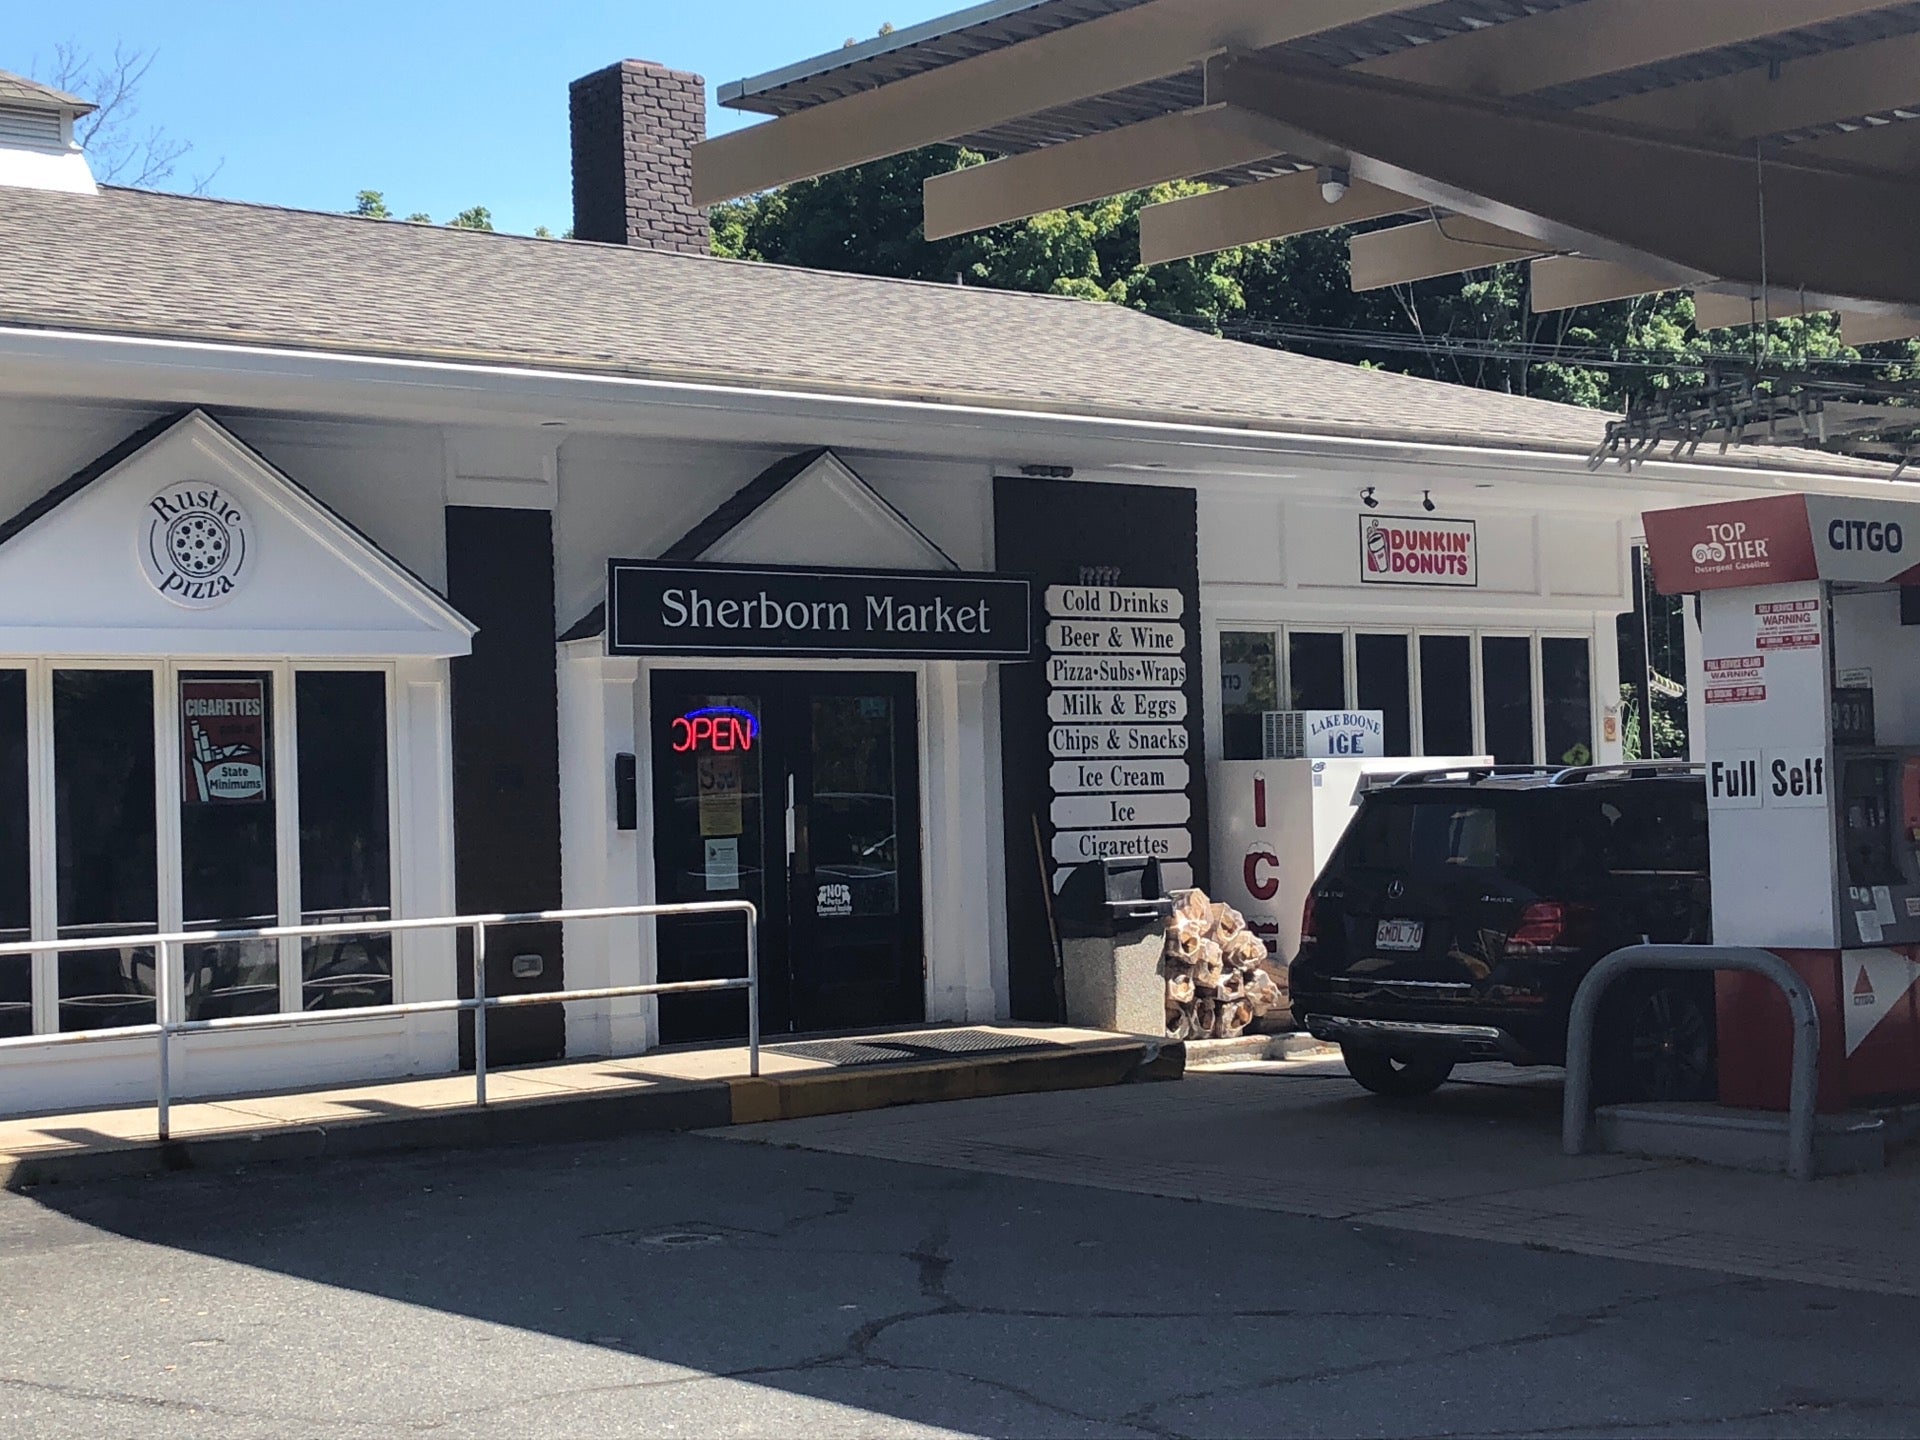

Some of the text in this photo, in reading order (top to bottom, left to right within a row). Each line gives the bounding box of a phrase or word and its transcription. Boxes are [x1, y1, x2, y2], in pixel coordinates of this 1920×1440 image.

[149, 489, 241, 525] Rustic
[1391, 529, 1471, 553] DUNKIN'
[1707, 522, 1746, 543] TOP
[1828, 519, 1903, 553] CITGO
[1725, 540, 1768, 560] TIER
[1391, 552, 1468, 576] DONUTS
[1694, 561, 1770, 574] Detergent Gasoline
[661, 588, 992, 634] Sherborn Market
[1062, 589, 1169, 613] Cold Drinks
[1762, 613, 1811, 625] WARNING
[1060, 625, 1174, 648] Beer & Wine
[1710, 670, 1759, 680] WARNING
[185, 698, 261, 717] CIGARETTES
[1062, 694, 1177, 719] Milk & Eggs
[672, 717, 752, 752] OPEN
[1311, 713, 1381, 736] LAKE BOONE
[1053, 728, 1187, 754] Chips & Snacks
[1328, 730, 1365, 755] ICE
[221, 767, 249, 777] State
[1078, 765, 1165, 787] Ice Cream
[1711, 760, 1757, 798] Full
[1771, 757, 1823, 797] Self
[210, 779, 262, 790] Minimums
[1110, 801, 1135, 822] Ice
[1079, 834, 1169, 859] Cigarettes
[826, 884, 841, 897] NO
